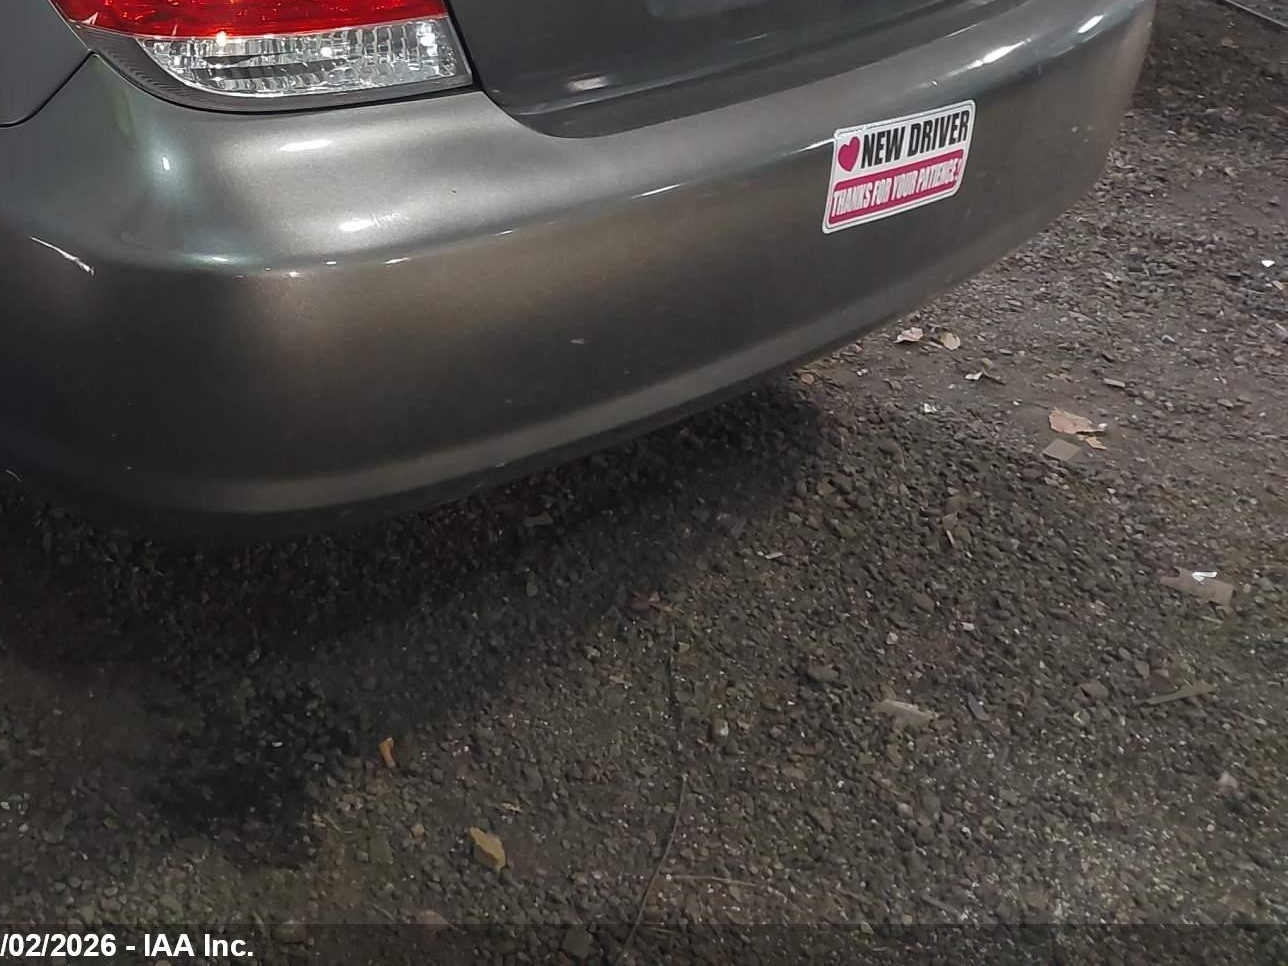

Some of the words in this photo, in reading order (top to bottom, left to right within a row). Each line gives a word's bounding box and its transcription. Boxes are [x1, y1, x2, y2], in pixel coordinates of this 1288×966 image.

[861, 126, 906, 169] NEW
[907, 110, 970, 157] DRIVER
[831, 183, 872, 217] THANKS
[871, 178, 893, 206] FOR
[892, 170, 919, 201] YOUR
